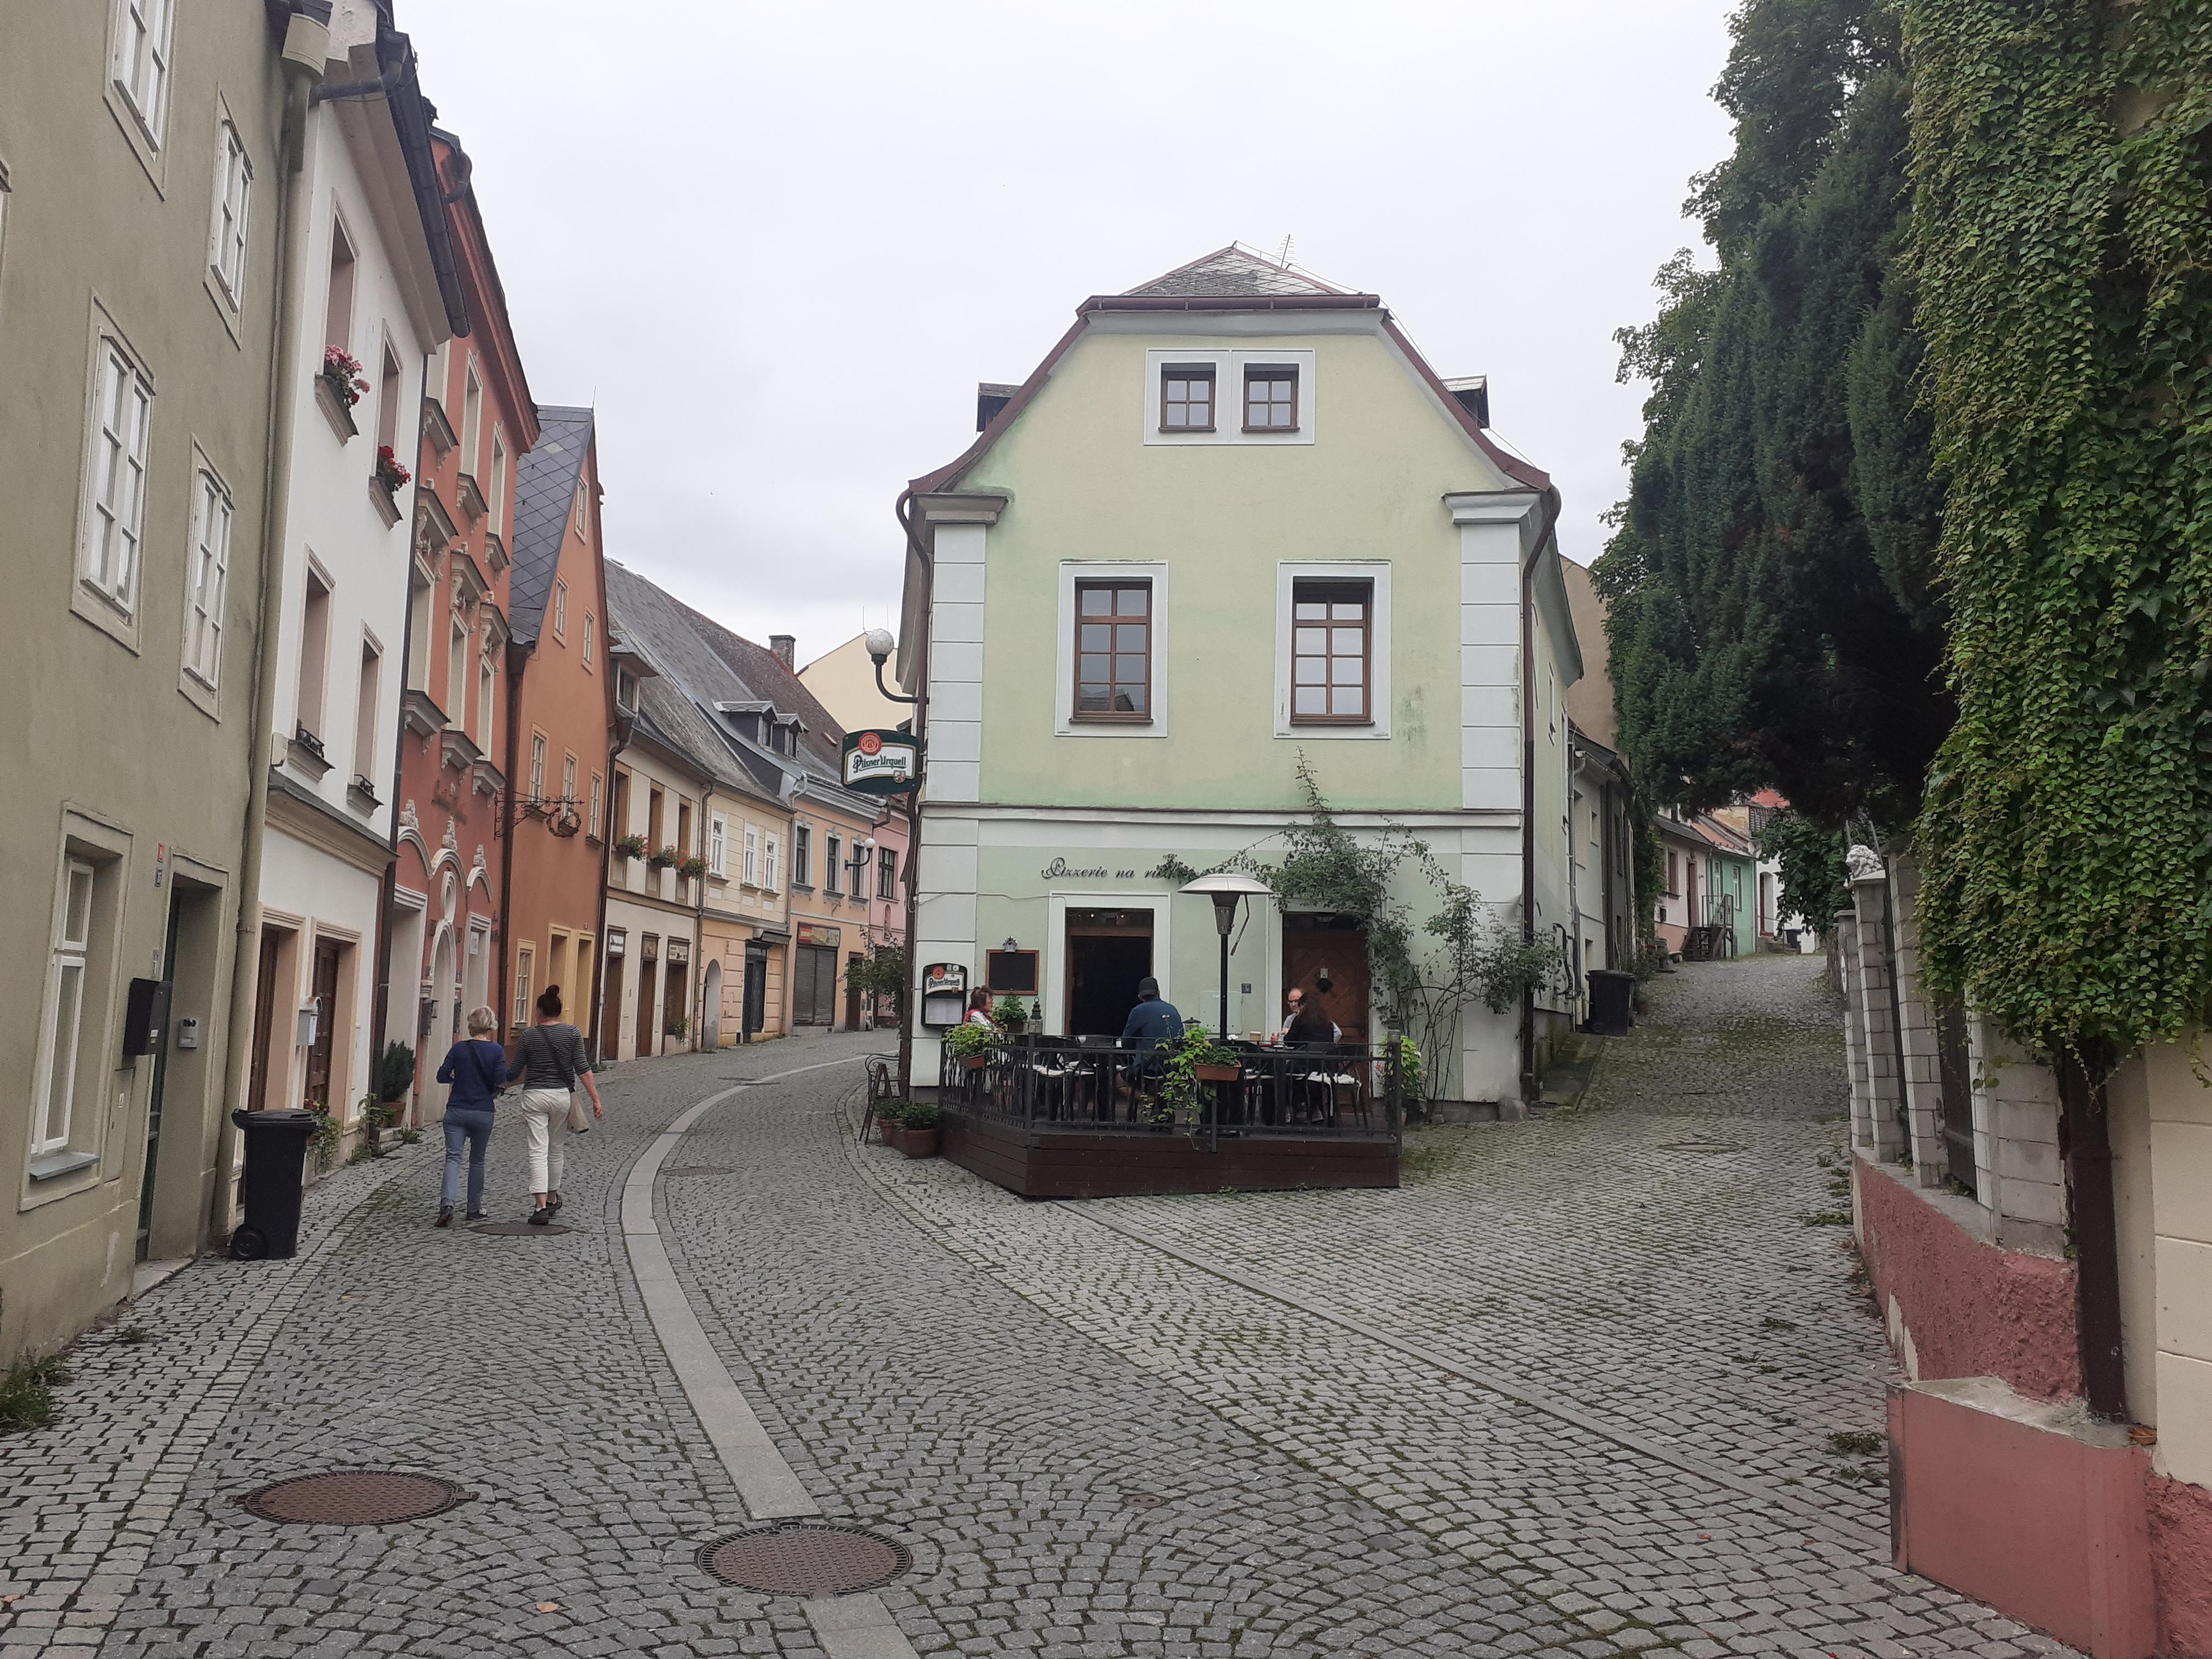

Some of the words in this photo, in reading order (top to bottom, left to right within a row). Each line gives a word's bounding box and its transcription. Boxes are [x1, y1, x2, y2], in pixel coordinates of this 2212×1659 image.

[853, 754, 880, 774] Pilsner
[880, 754, 906, 769] Urquell
[1041, 857, 1108, 879] Pizzerie
[1115, 869, 1135, 878] na
